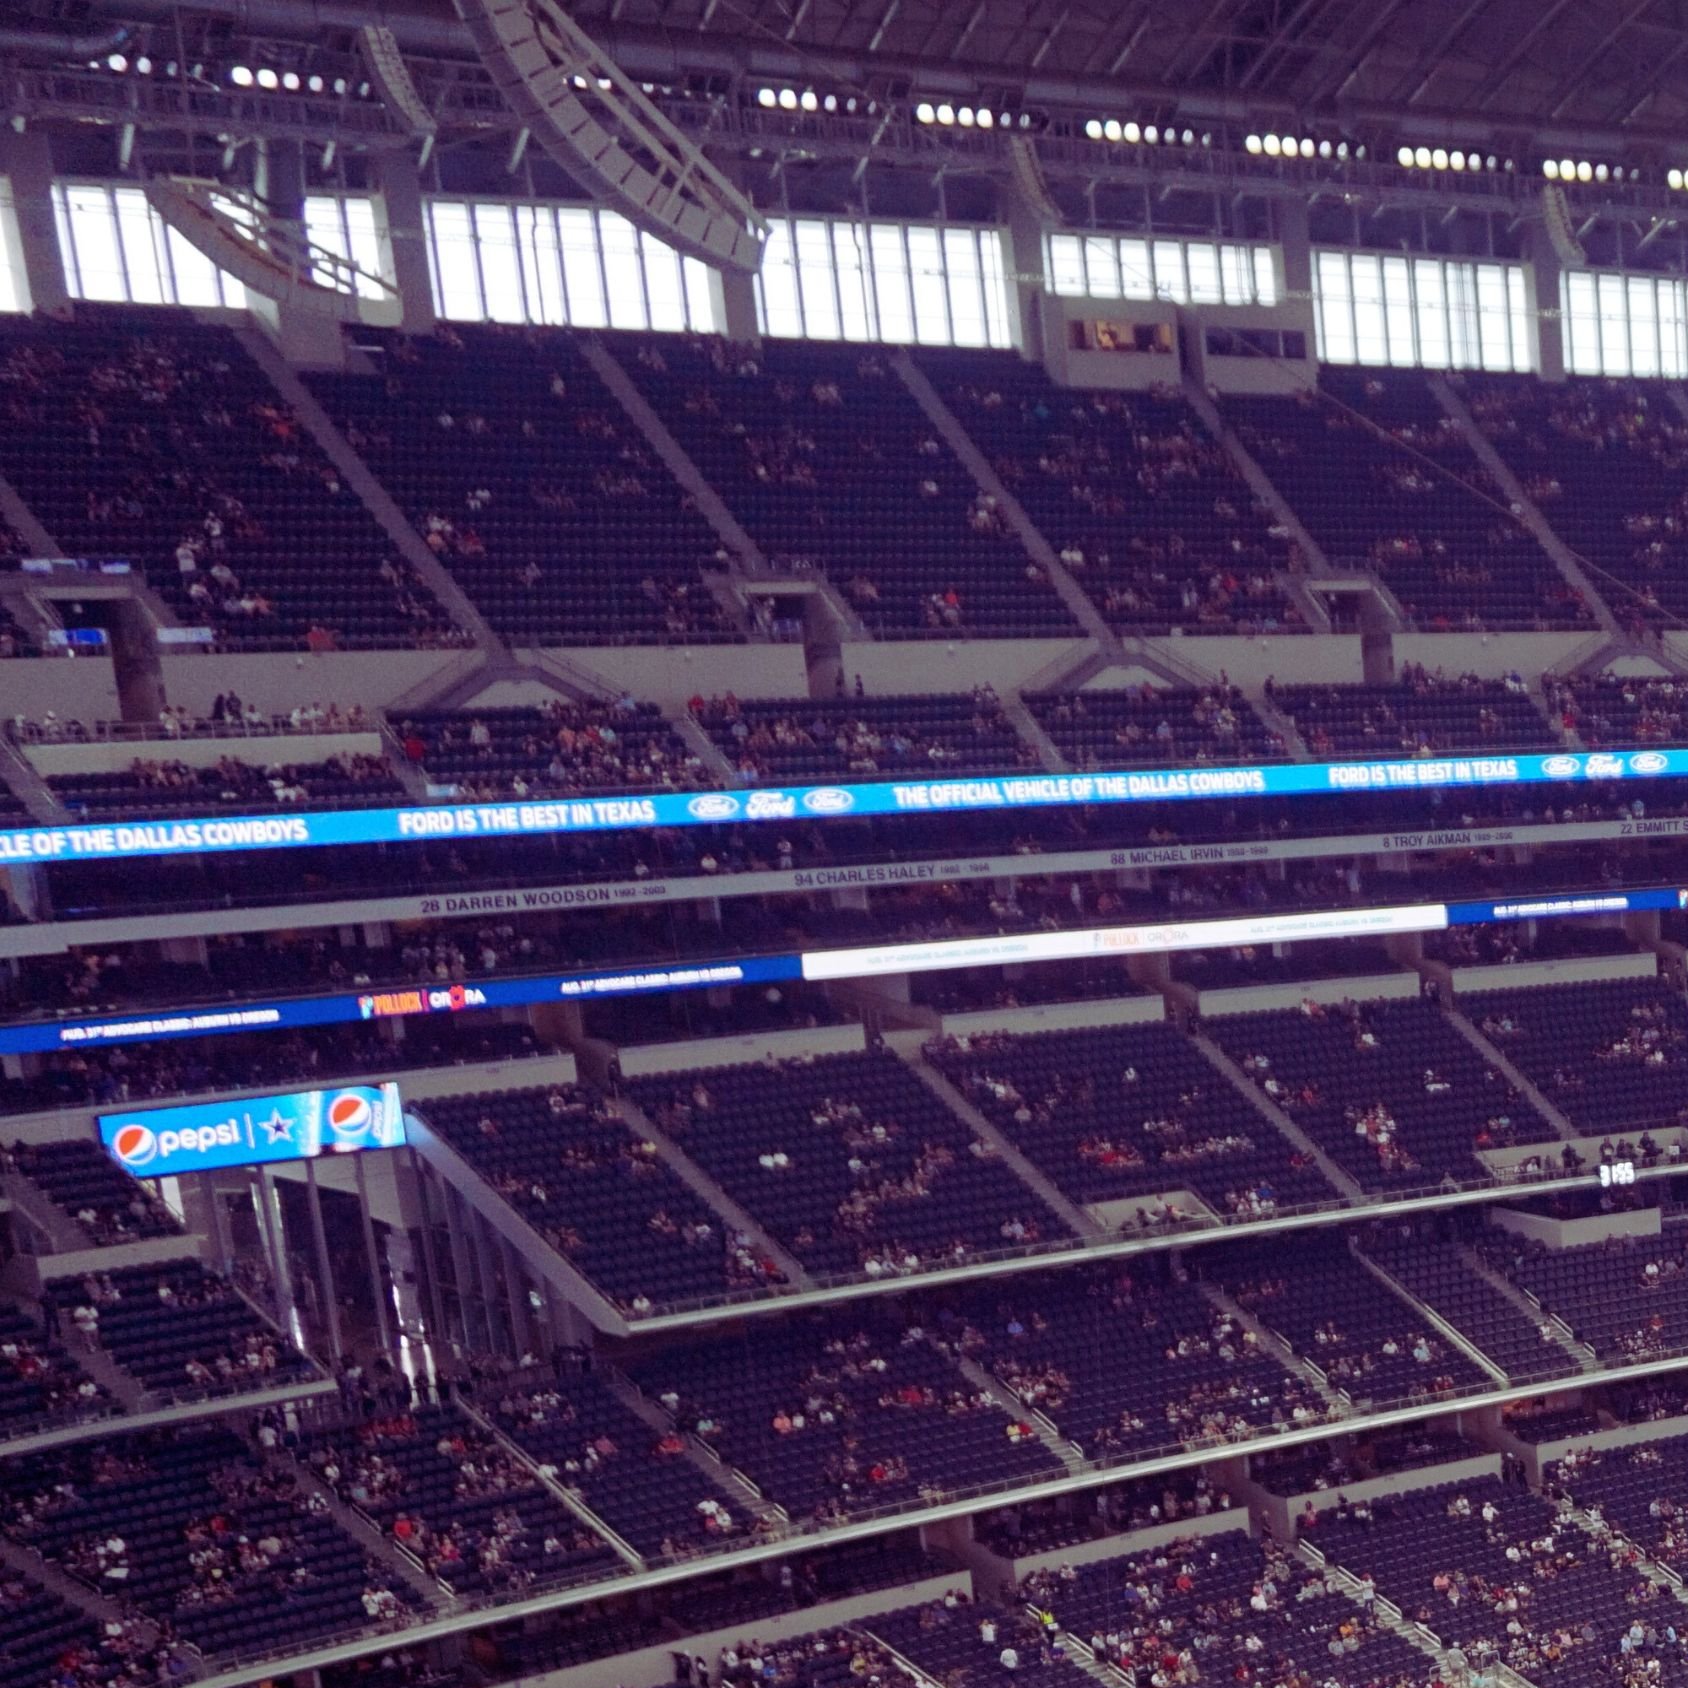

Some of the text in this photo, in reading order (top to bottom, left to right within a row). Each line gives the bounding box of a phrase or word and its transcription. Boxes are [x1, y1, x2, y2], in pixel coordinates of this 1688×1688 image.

[1328, 759, 1518, 786] FORD IS THE BEST IN TEXAS
[1584, 754, 1624, 776] Ford
[893, 770, 1265, 809] THE OFFICIAL VEHICLE OF THE DALLAS COWBOYS
[398, 800, 656, 834] FORD IS THE BEST IN TEXAS
[745, 791, 796, 820] Ford
[0, 818, 309, 857] LE OF THE DALLAS COWBOYS
[1620, 822, 1633, 834] 22
[1636, 820, 1680, 834] EMMITT
[1383, 832, 1471, 849] 8 TROY AIKMAN
[1110, 846, 1225, 865] 88 MICHAEL IRVIN
[794, 873, 814, 887] 94
[815, 868, 886, 885] CHARLES
[888, 863, 936, 882] HALEY
[421, 888, 611, 914] 28 DARREN WOODSON
[158, 1118, 243, 1159] pepsi
